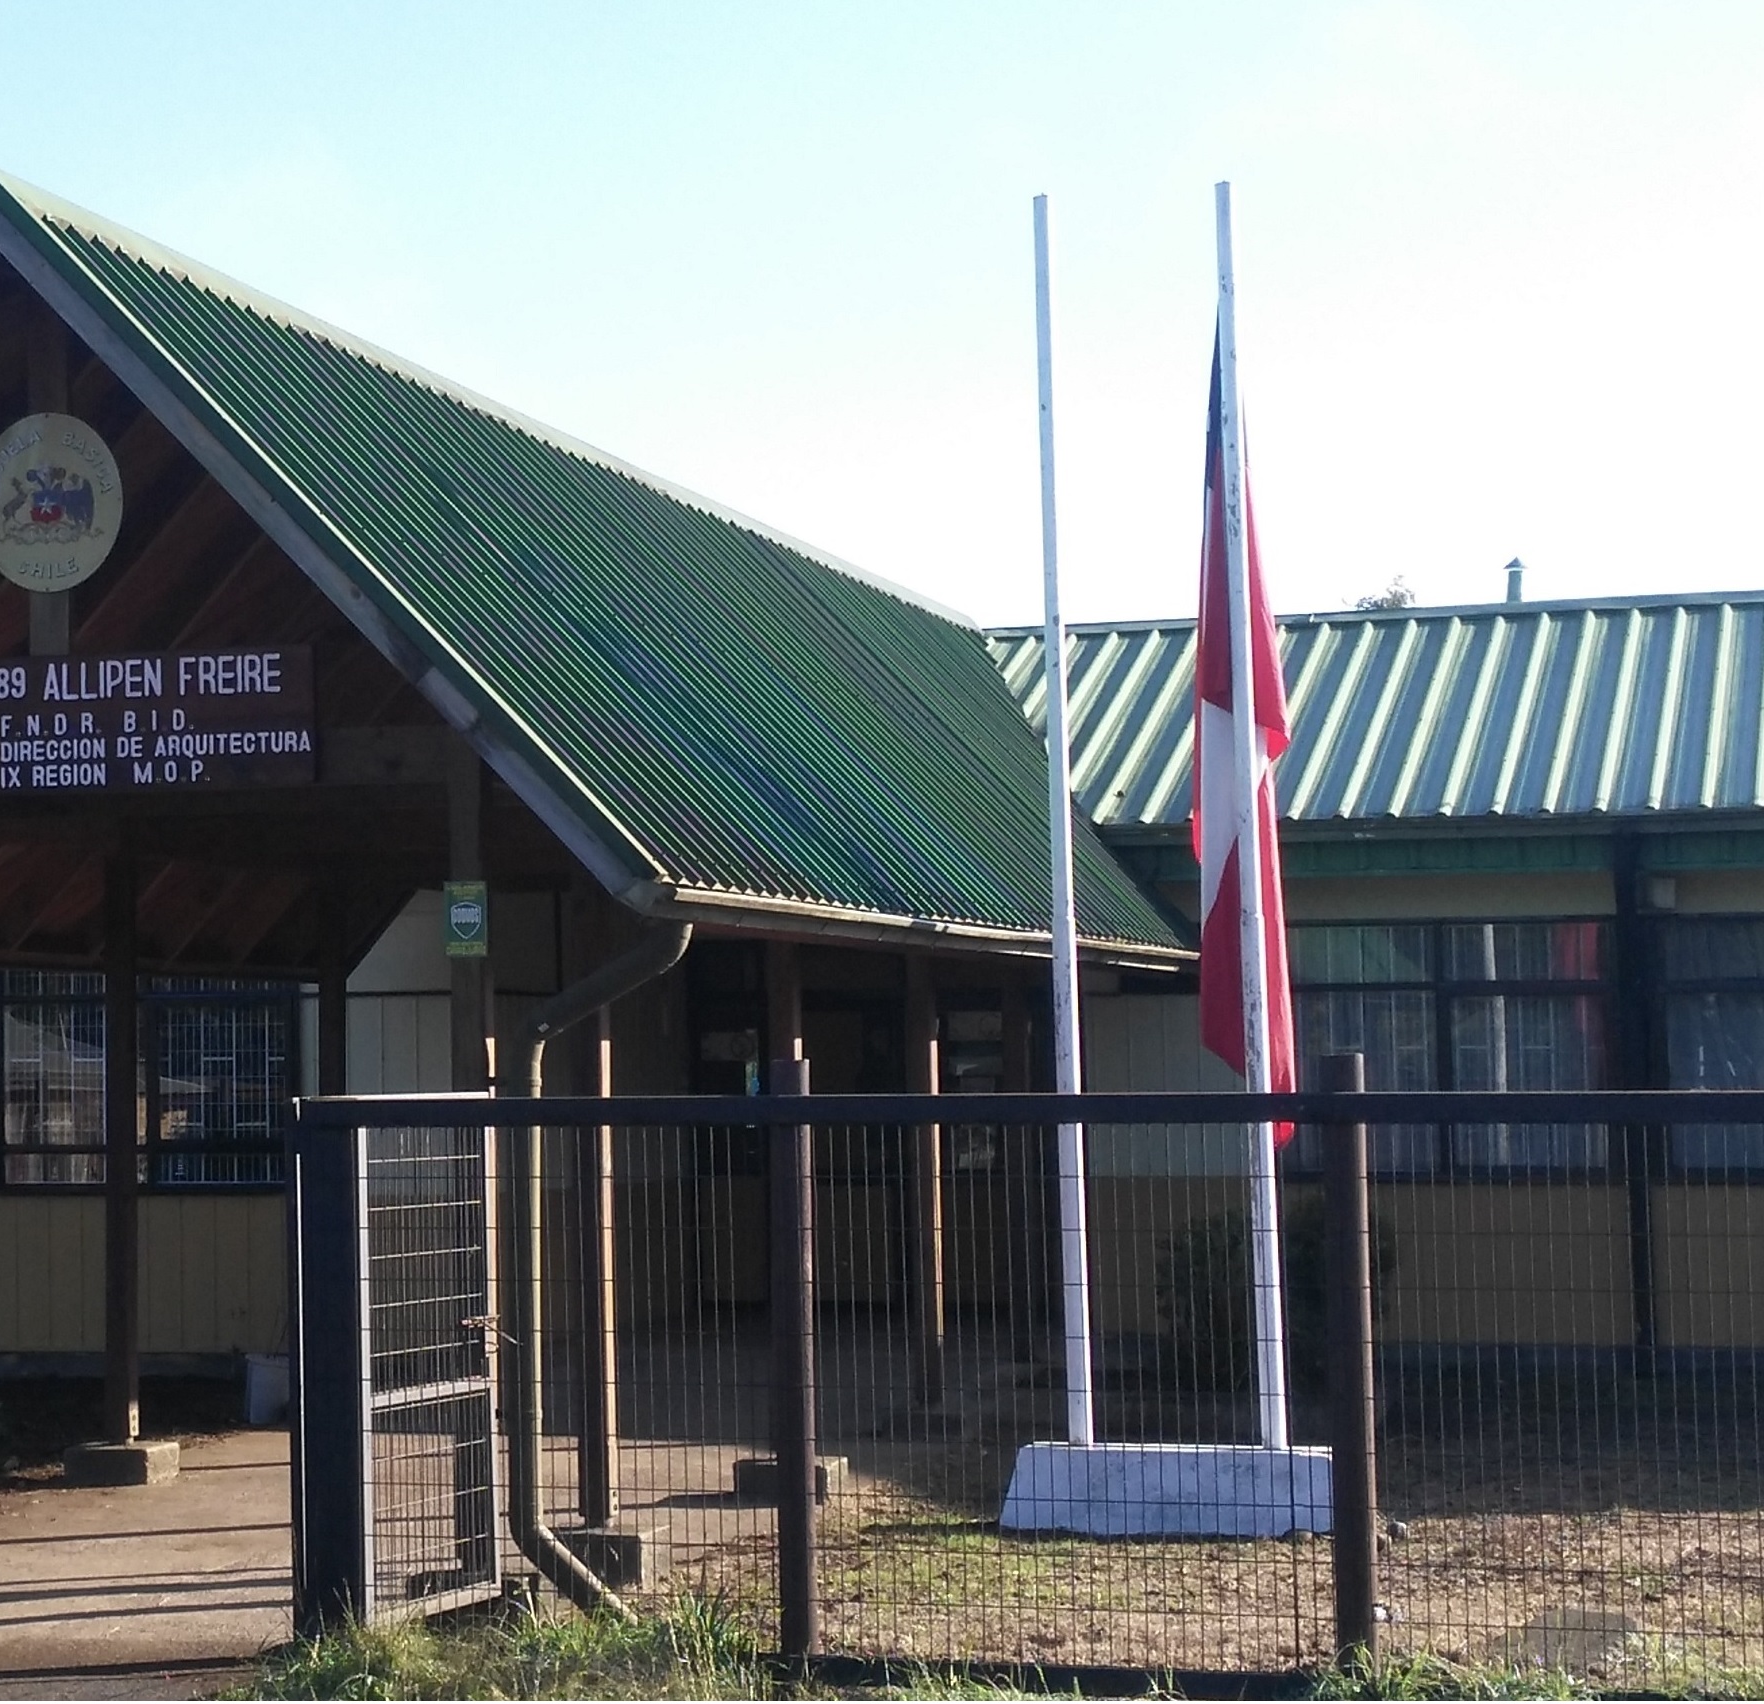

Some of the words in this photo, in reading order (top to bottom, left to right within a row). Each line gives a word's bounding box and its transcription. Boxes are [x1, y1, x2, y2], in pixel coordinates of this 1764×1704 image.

[18, 557, 80, 580] CHILE
[43, 658, 163, 701] ALLIPEN
[178, 652, 282, 696] FREIRE
[0, 737, 106, 763] DIRECCION
[116, 736, 143, 758] DE
[154, 730, 312, 758] ARQUITECTURA
[0, 765, 21, 789] IX
[31, 762, 106, 788] REGION
